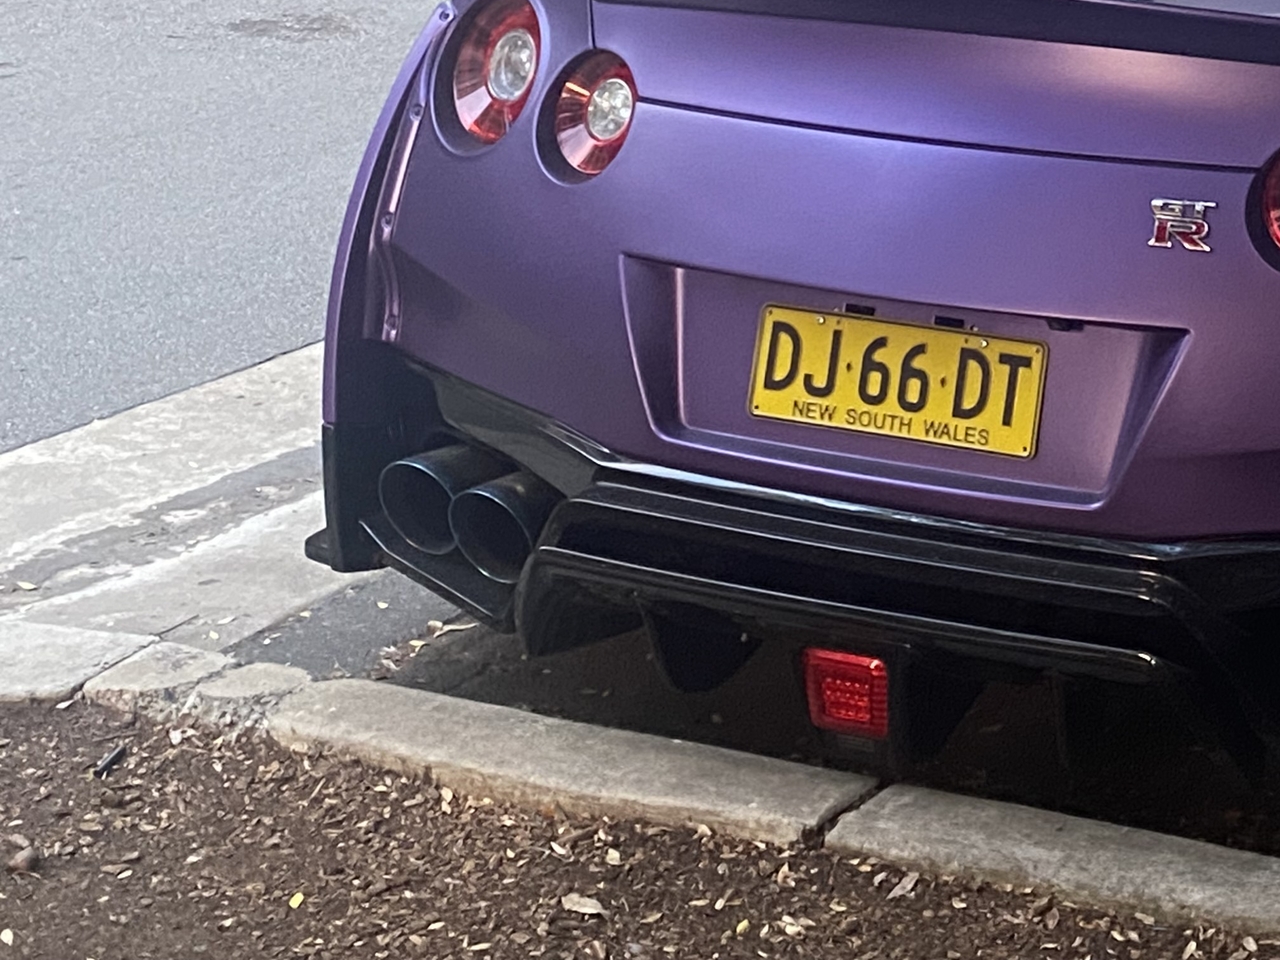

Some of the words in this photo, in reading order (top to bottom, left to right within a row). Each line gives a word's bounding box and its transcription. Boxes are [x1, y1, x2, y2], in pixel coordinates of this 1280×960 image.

[791, 401, 837, 422] NEW
[845, 408, 913, 435] SOUTH
[924, 419, 990, 446] WALES
